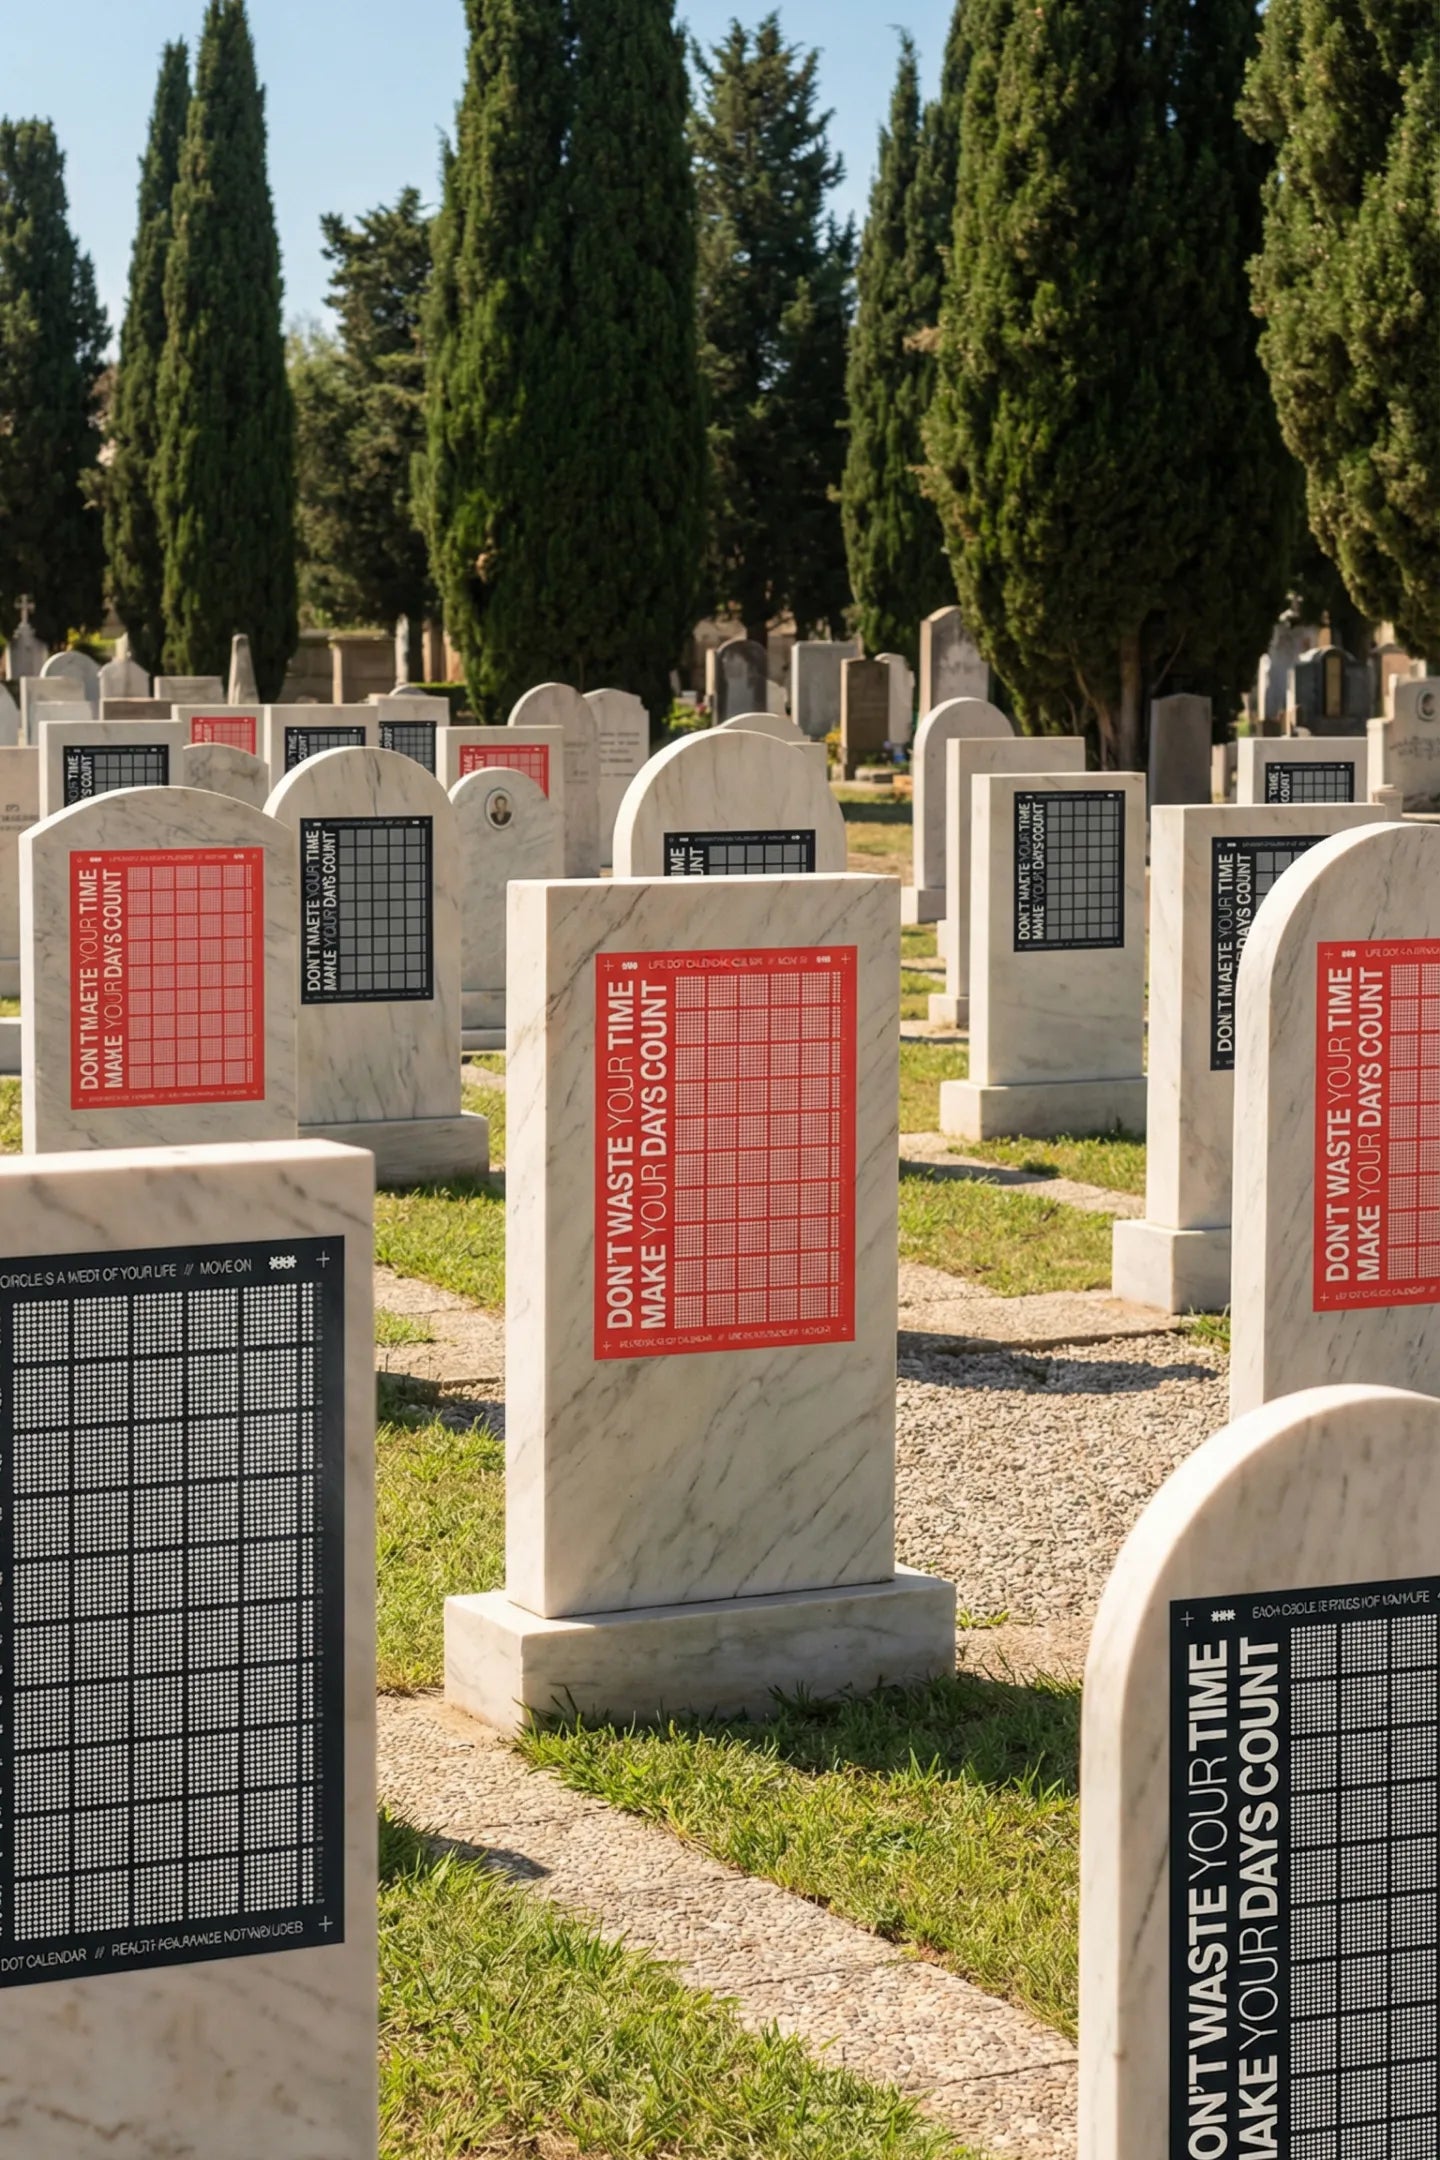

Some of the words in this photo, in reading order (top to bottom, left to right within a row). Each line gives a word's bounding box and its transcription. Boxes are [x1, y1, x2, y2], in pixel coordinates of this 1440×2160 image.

[305, 830, 319, 864] TIME
[322, 830, 336, 873] COUNT
[1217, 853, 1233, 894] TIME
[1236, 853, 1251, 905] COUNT
[79, 868, 98, 914] TIME
[103, 868, 122, 930] COUNT
[1217, 897, 1233, 938] YOUR
[79, 917, 98, 964] YOUR
[103, 933, 122, 978] DAYS
[103, 981, 123, 1028] YOUR
[608, 980, 634, 1050] TIME
[640, 980, 668, 1081] COUNT
[1328, 967, 1352, 1032] TIME
[1357, 967, 1383, 1057] COUNT
[607, 1056, 634, 1131] YOUR
[1327, 1036, 1352, 1104] YOUR
[1357, 1062, 1382, 1127] DAYS
[640, 1086, 667, 1157] DAYS
[1326, 1108, 1351, 1198] WASTE
[606, 1136, 633, 1237] WASTE
[640, 1164, 667, 1240] YOUR
[1357, 1133, 1382, 1200] YOUR
[102, 1267, 119, 1281] OF
[154, 1264, 177, 1278] LIFE
[200, 1260, 233, 1275] MOVE
[234, 1259, 252, 1273] ON
[1325, 1203, 1350, 1282] DON'T
[1356, 1204, 1381, 1281] MAKE
[606, 1242, 633, 1329] DON'T
[640, 1244, 667, 1329] MAKE
[1188, 1639, 1228, 1752] TIME
[1238, 1637, 1280, 1796] COUNT
[1188, 1756, 1228, 1881] YOUR
[1238, 1801, 1279, 1919] DAYS
[1, 1956, 24, 1971] DOT
[26, 1948, 87, 1968] CALENDAR
[1187, 1885, 1228, 2050] WASTE
[1238, 1925, 1279, 2050] YOUR
[1187, 2054, 1228, 2160] ON'T
[1238, 2054, 1278, 2160] AKE
